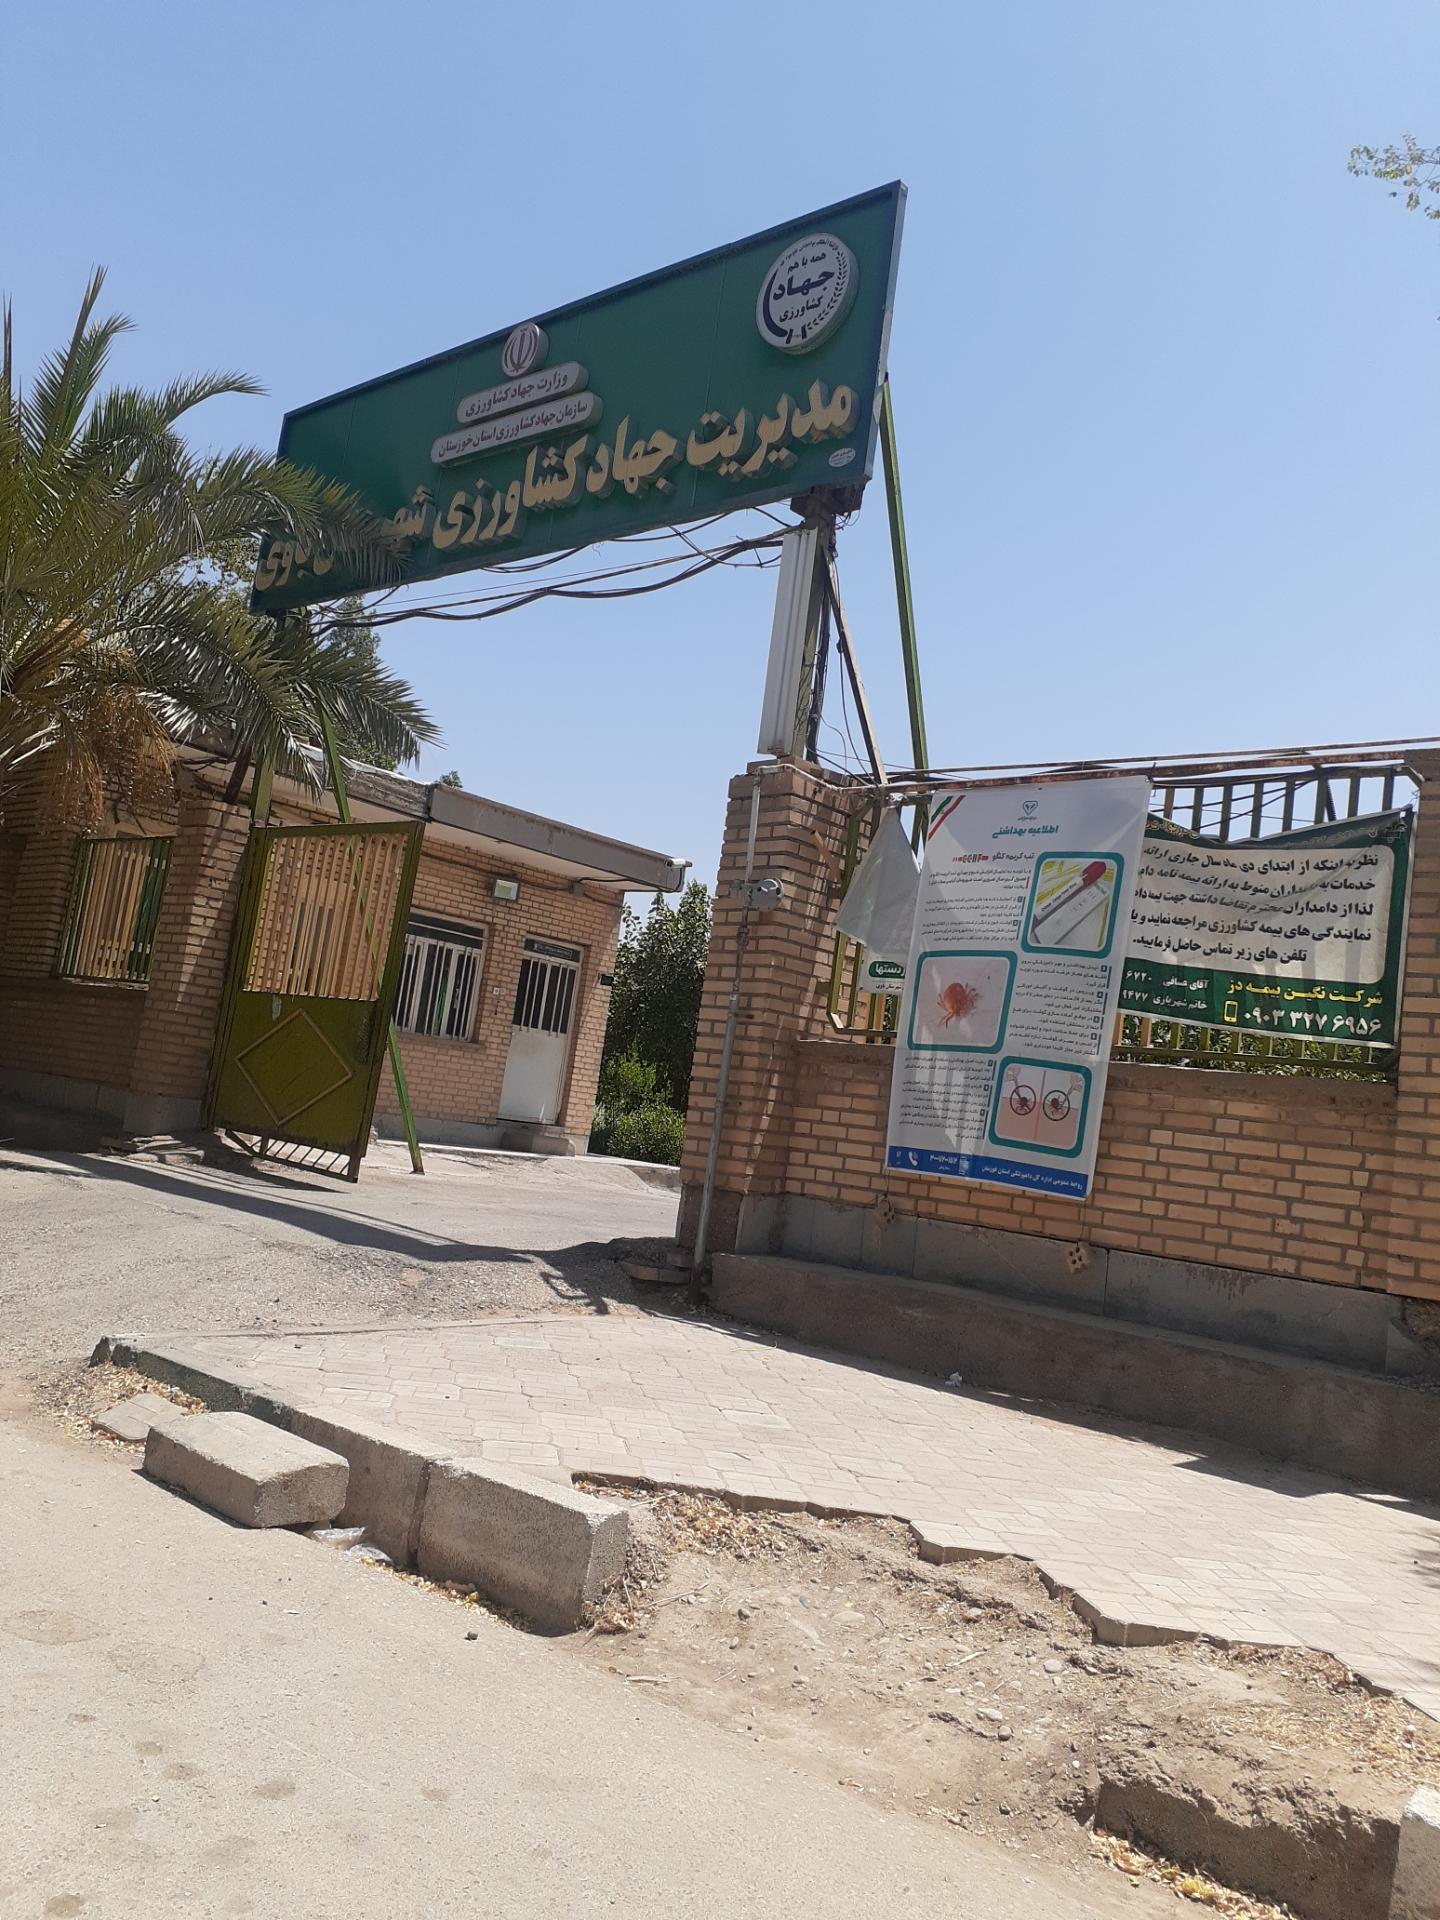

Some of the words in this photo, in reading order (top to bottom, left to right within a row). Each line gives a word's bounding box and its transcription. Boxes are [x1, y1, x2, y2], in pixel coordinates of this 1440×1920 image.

[801, 256, 808, 269] با
[810, 252, 827, 264] همه
[787, 261, 800, 275] هم
[772, 270, 835, 301] جهاد
[779, 295, 824, 323] کشاورزی
[536, 369, 568, 393] وزارت
[510, 382, 535, 398] جهاد
[465, 386, 511, 417] کشاورزی
[535, 410, 556, 427] جهاد
[555, 401, 588, 423] سازمان
[495, 414, 536, 441] کشاورزی
[686, 378, 854, 477] مدیریت
[472, 427, 496, 448] استان
[437, 438, 473, 458] خوزستان
[585, 415, 679, 495] جهاد
[432, 432, 591, 551] کشاورزی
[992, 824, 1027, 839] بهداشتی
[1027, 824, 1060, 837] اطلاعیه
[1143, 846, 1169, 860] ارائه
[1168, 852, 1200, 867] جاری
[1200, 854, 1222, 868] سال
[1239, 862, 1255, 874] دی
[1257, 859, 1295, 875] ابتدای
[1297, 859, 1310, 875] از
[1313, 858, 1344, 872] اینکه
[1156, 868, 1178, 878] نامه
[1178, 873, 1201, 885] بیمه
[1201, 876, 1227, 890] ارائه
[1240, 881, 1270, 896] منوط
[1330, 878, 1376, 891] خدمات
[1163, 891, 1187, 905] جهت
[1189, 894, 1219, 905] داشته
[1283, 900, 1339, 916] دامداران
[1339, 902, 1353, 917] از
[1130, 909, 1139, 923] یا
[1137, 915, 1146, 925] و
[1171, 914, 1208, 931] مراجعه
[1207, 919, 1259, 935] کشاورزی
[1258, 924, 1283, 938] بیمه
[1283, 924, 1311, 939] های
[1311, 926, 1372, 942] نمایندگی
[1172, 938, 1202, 953] حاصل
[1202, 941, 1233, 957] تماس
[1234, 945, 1252, 961] زیر
[1253, 947, 1279, 961] های
[1280, 948, 1308, 964] تلفن
[1188, 979, 1210, 991] آقای
[1226, 979, 1243, 994] دز
[1245, 981, 1282, 998] بیمه
[1283, 985, 1326, 1002] نگین
[1328, 988, 1383, 1008] شرکت
[1152, 995, 1188, 1008] شهریاری
[1188, 999, 1209, 1010] خانم
[1243, 1006, 1285, 1026] ۰۹۰۳
[1289, 1010, 1328, 1031] ۳۲۷
[1331, 1014, 1383, 1036] ۶۹۵۶
